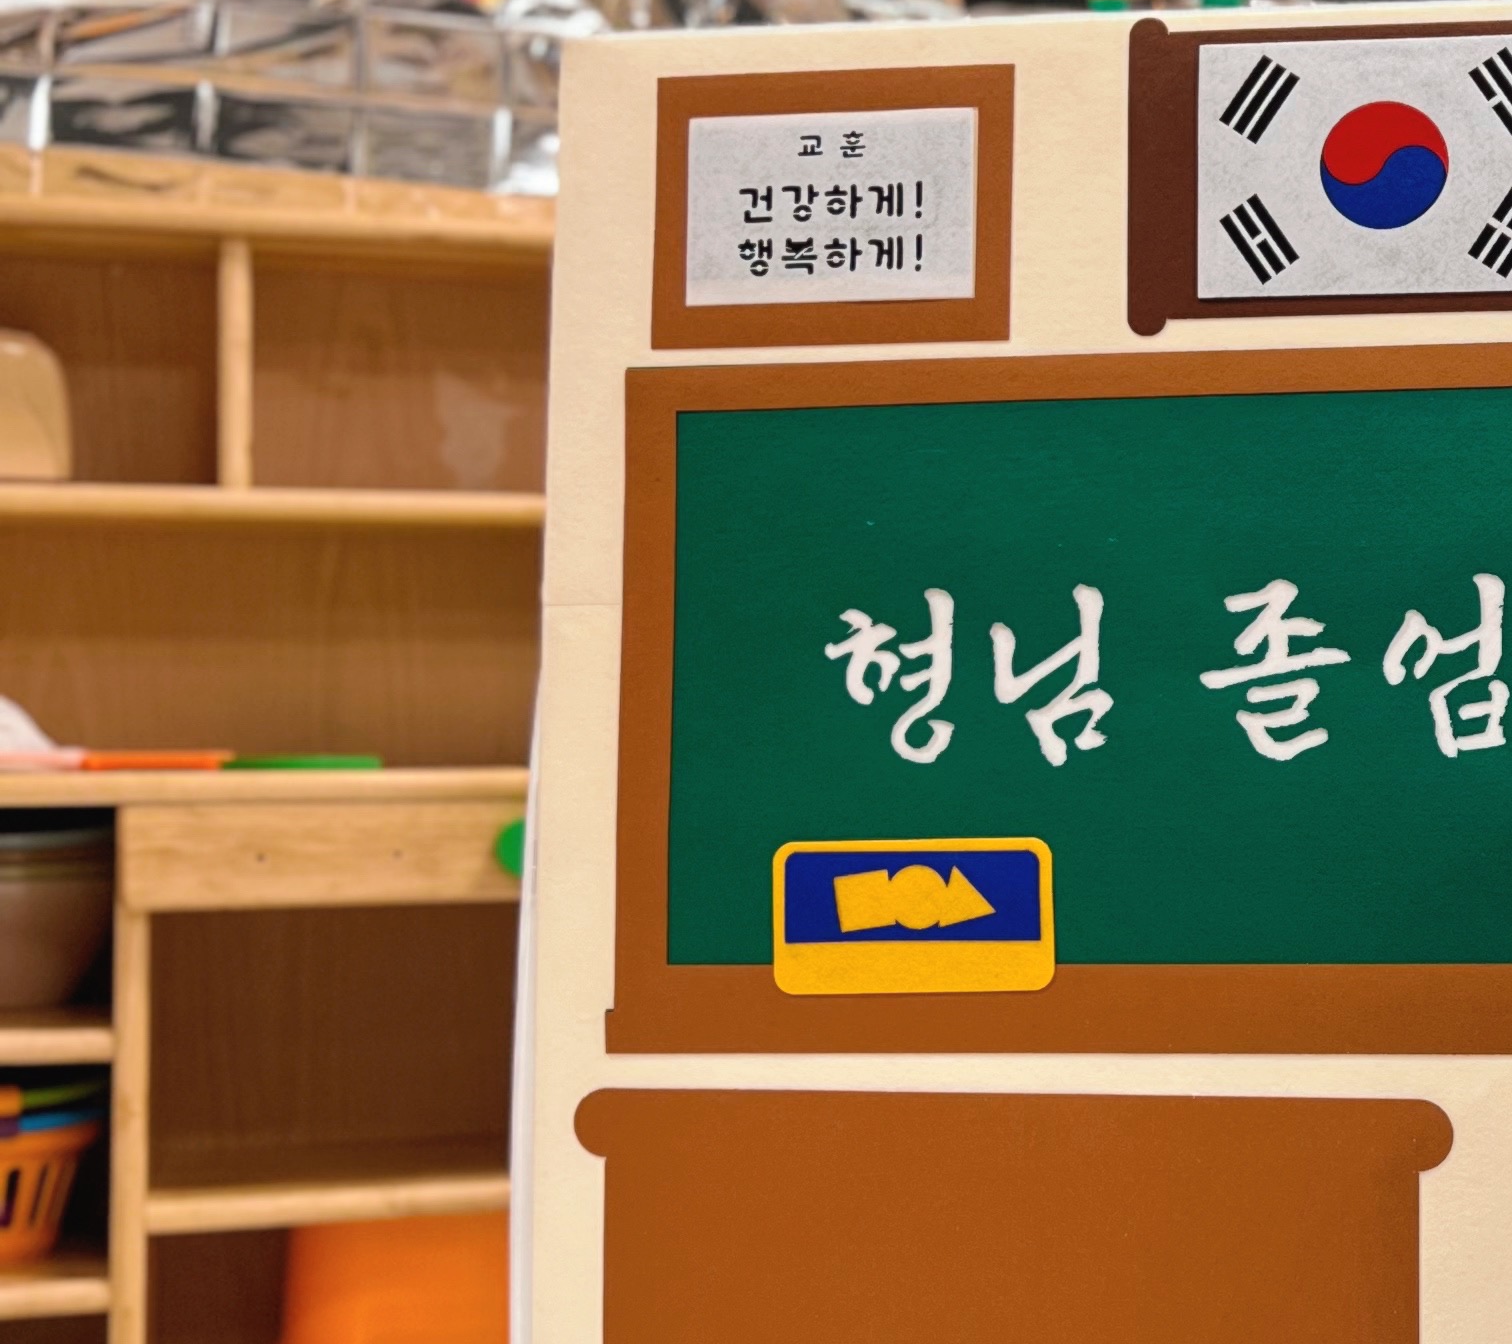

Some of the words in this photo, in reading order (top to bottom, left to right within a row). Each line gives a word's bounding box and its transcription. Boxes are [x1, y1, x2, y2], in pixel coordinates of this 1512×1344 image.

[738, 179, 924, 224] 건강하게!
[736, 232, 924, 278] 행복하게!
[824, 584, 1115, 768] 형님
